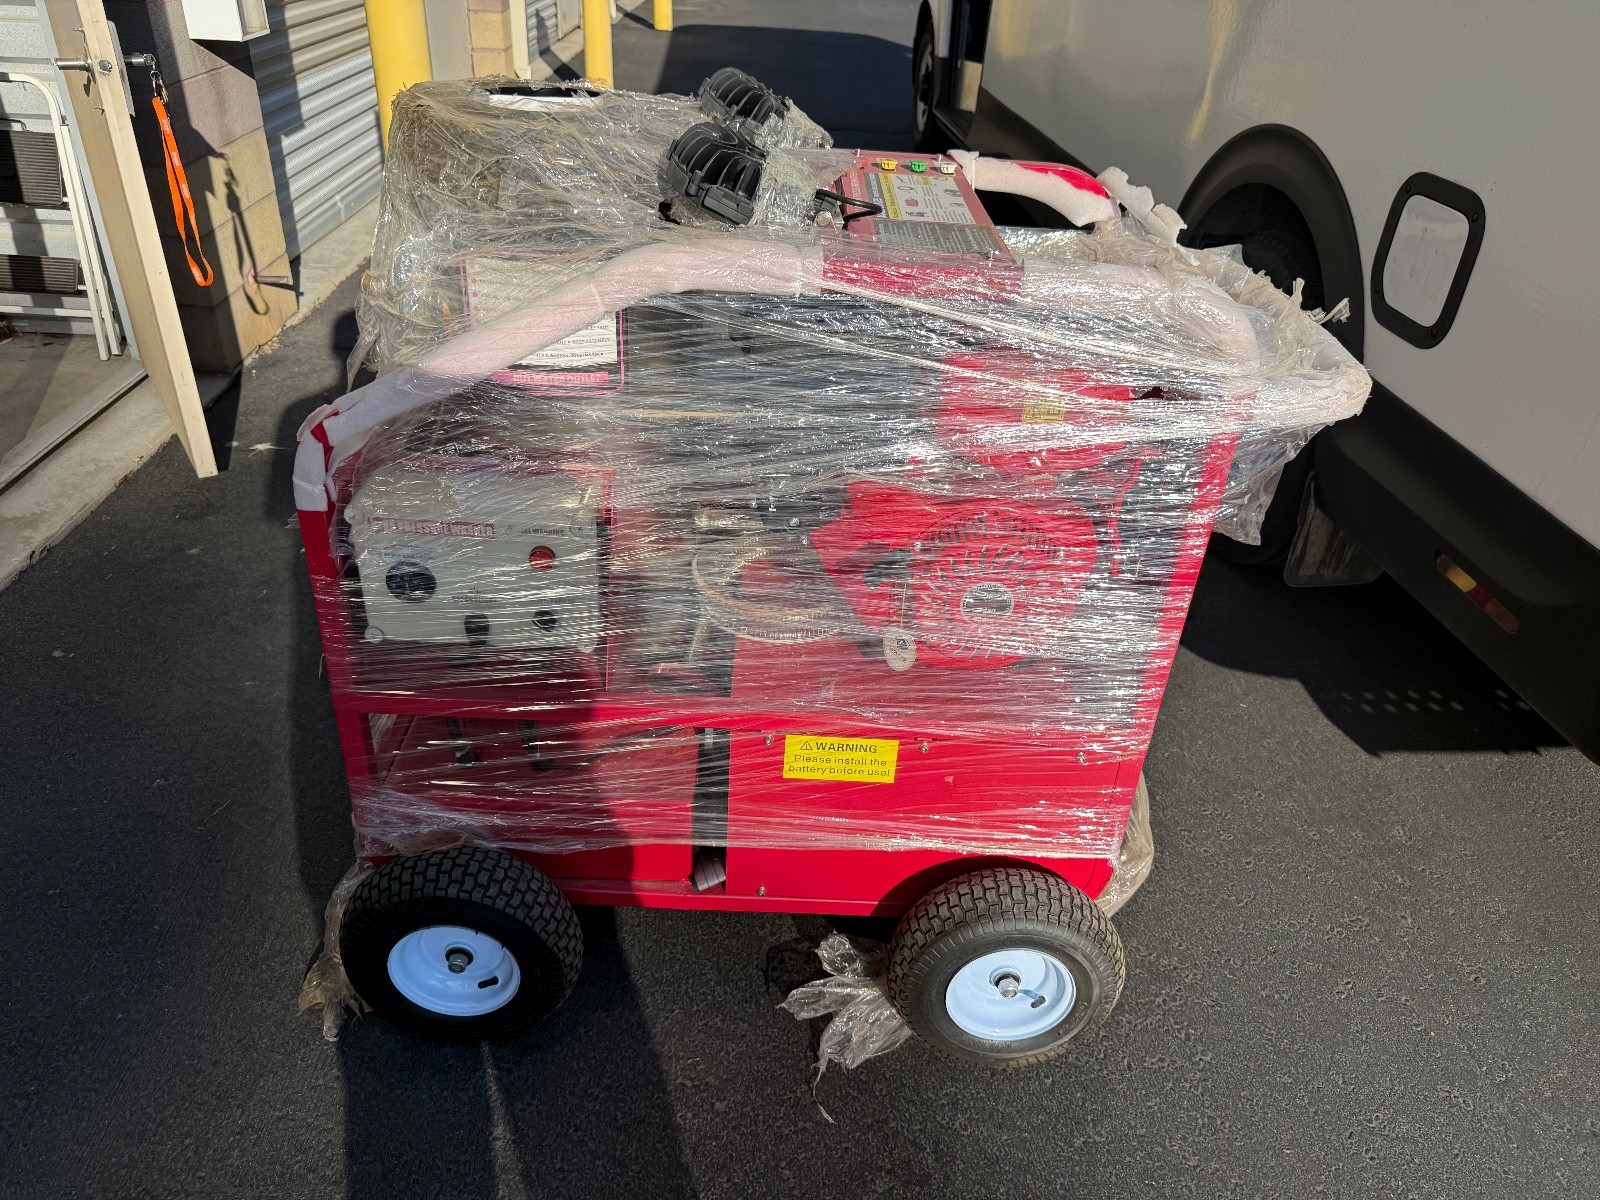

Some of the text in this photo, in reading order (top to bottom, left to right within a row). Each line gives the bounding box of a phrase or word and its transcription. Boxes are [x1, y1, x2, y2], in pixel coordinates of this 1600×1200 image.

[451, 524, 494, 536] WASHER
[815, 741, 878, 754] WARNING
[794, 754, 887, 767] Please install the
[788, 765, 890, 777] battery before use!
